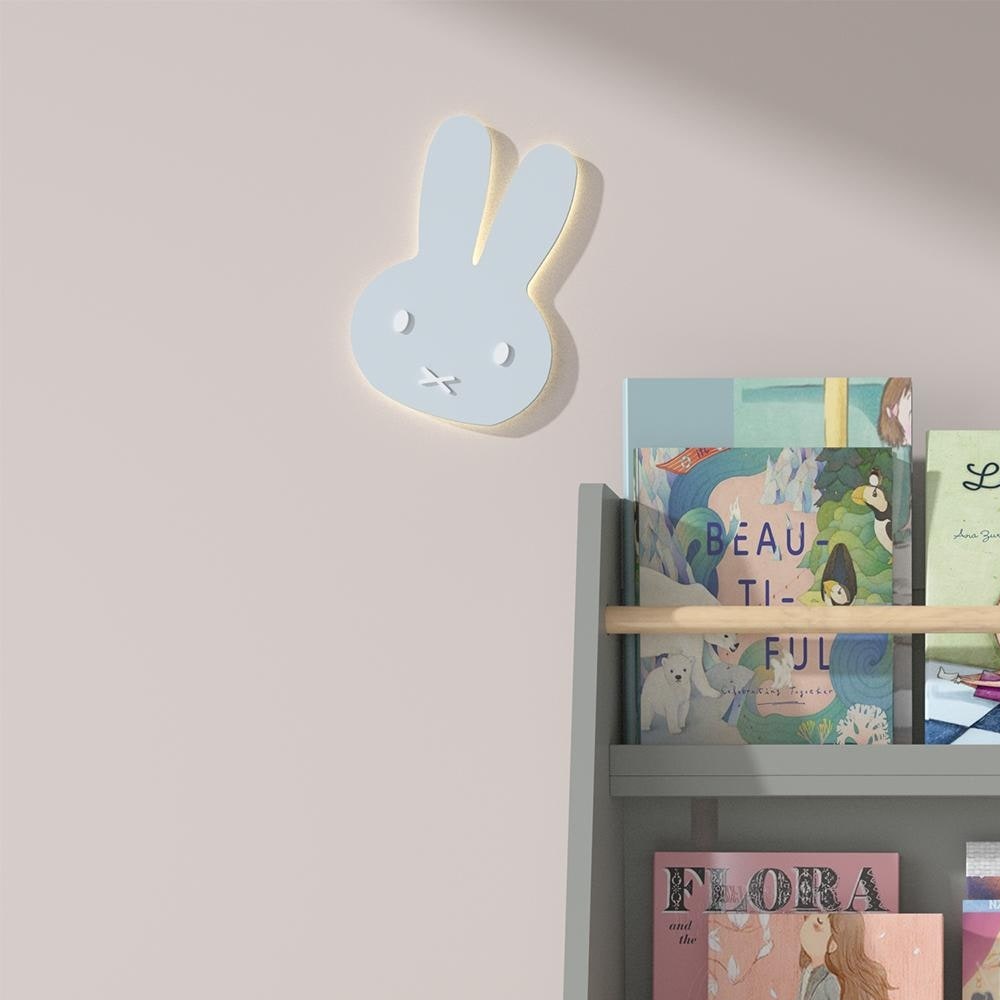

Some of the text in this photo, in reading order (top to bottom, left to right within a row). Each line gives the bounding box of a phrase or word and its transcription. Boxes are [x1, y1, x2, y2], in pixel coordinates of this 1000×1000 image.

[953, 528, 979, 540] Ana
[765, 637, 830, 671] FUL
[662, 866, 891, 913] FLORA
[668, 920, 692, 931] and
[678, 934, 697, 945] the
